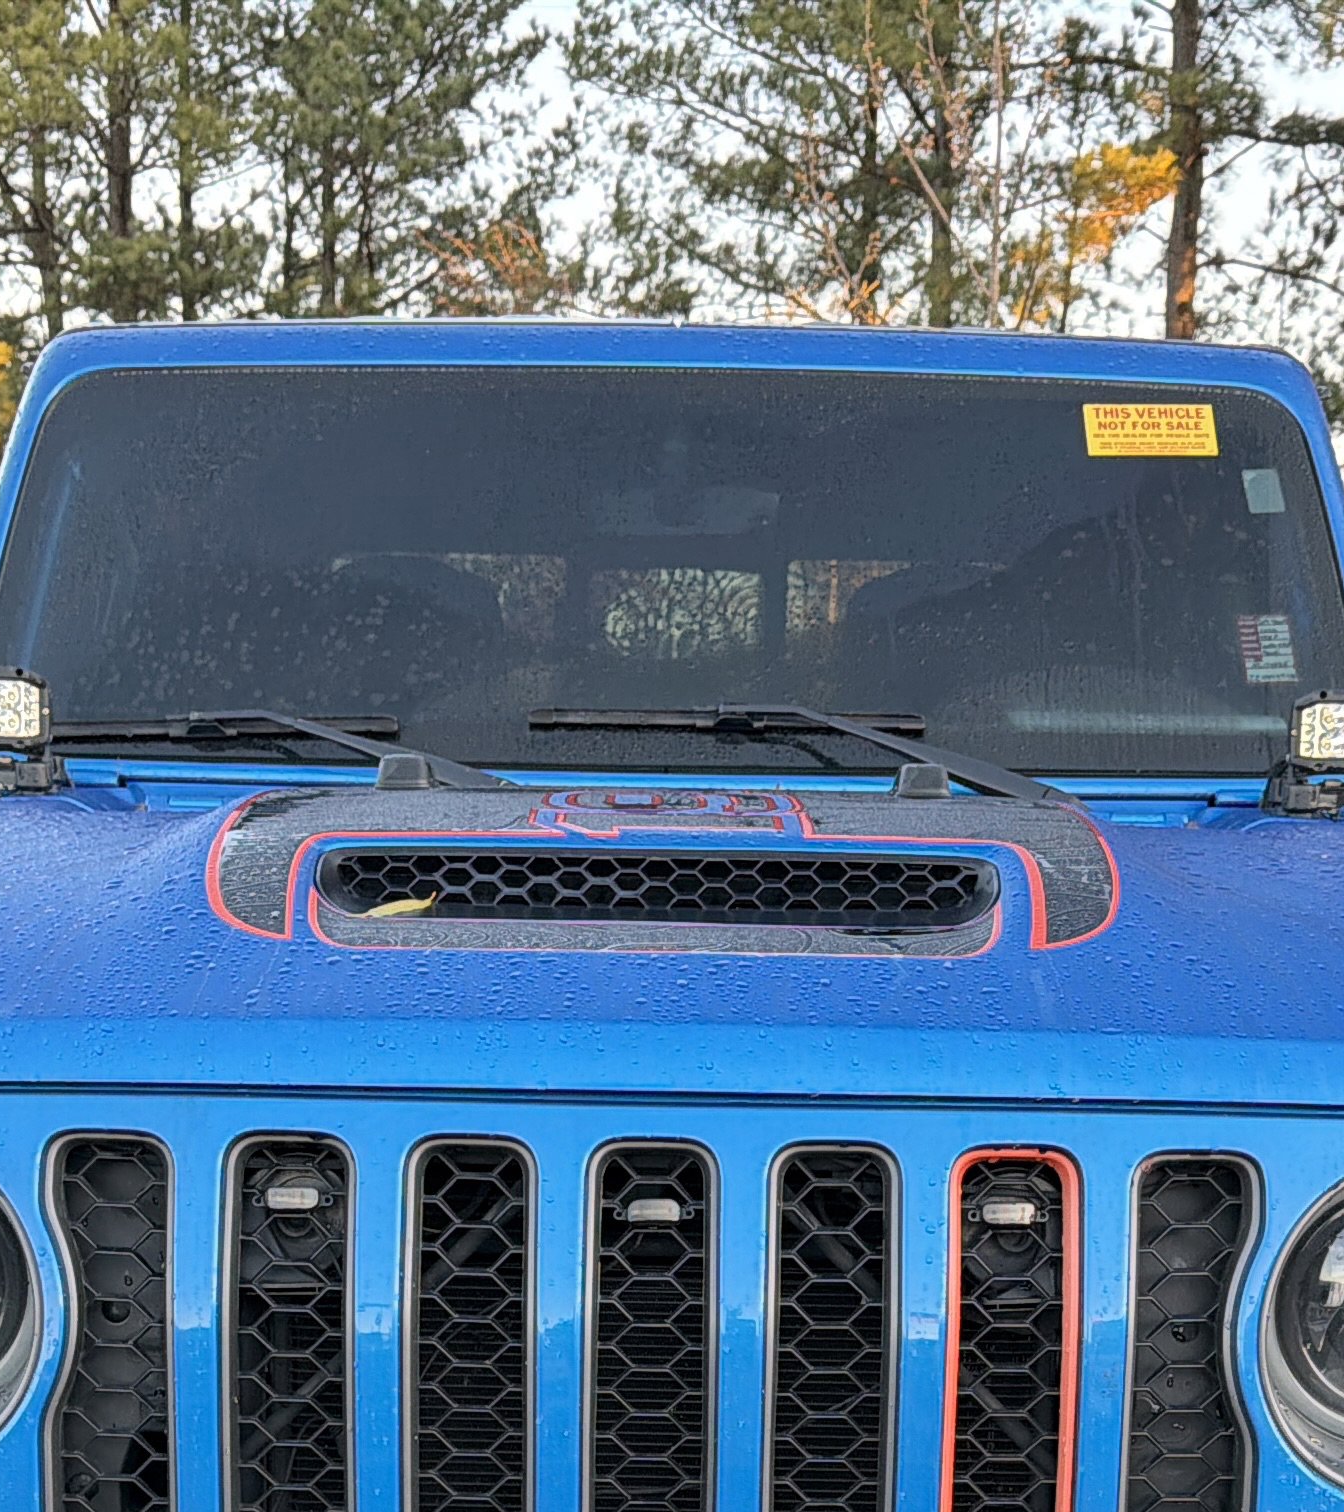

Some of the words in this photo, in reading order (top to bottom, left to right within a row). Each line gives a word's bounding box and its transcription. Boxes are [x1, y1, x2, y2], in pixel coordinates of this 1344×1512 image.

[1092, 407, 1131, 419] THIS
[1135, 407, 1206, 419] VEHICLE
[1097, 421, 1127, 431] NOT
[1132, 421, 1161, 431] FOR
[1165, 421, 1203, 431] SALE
